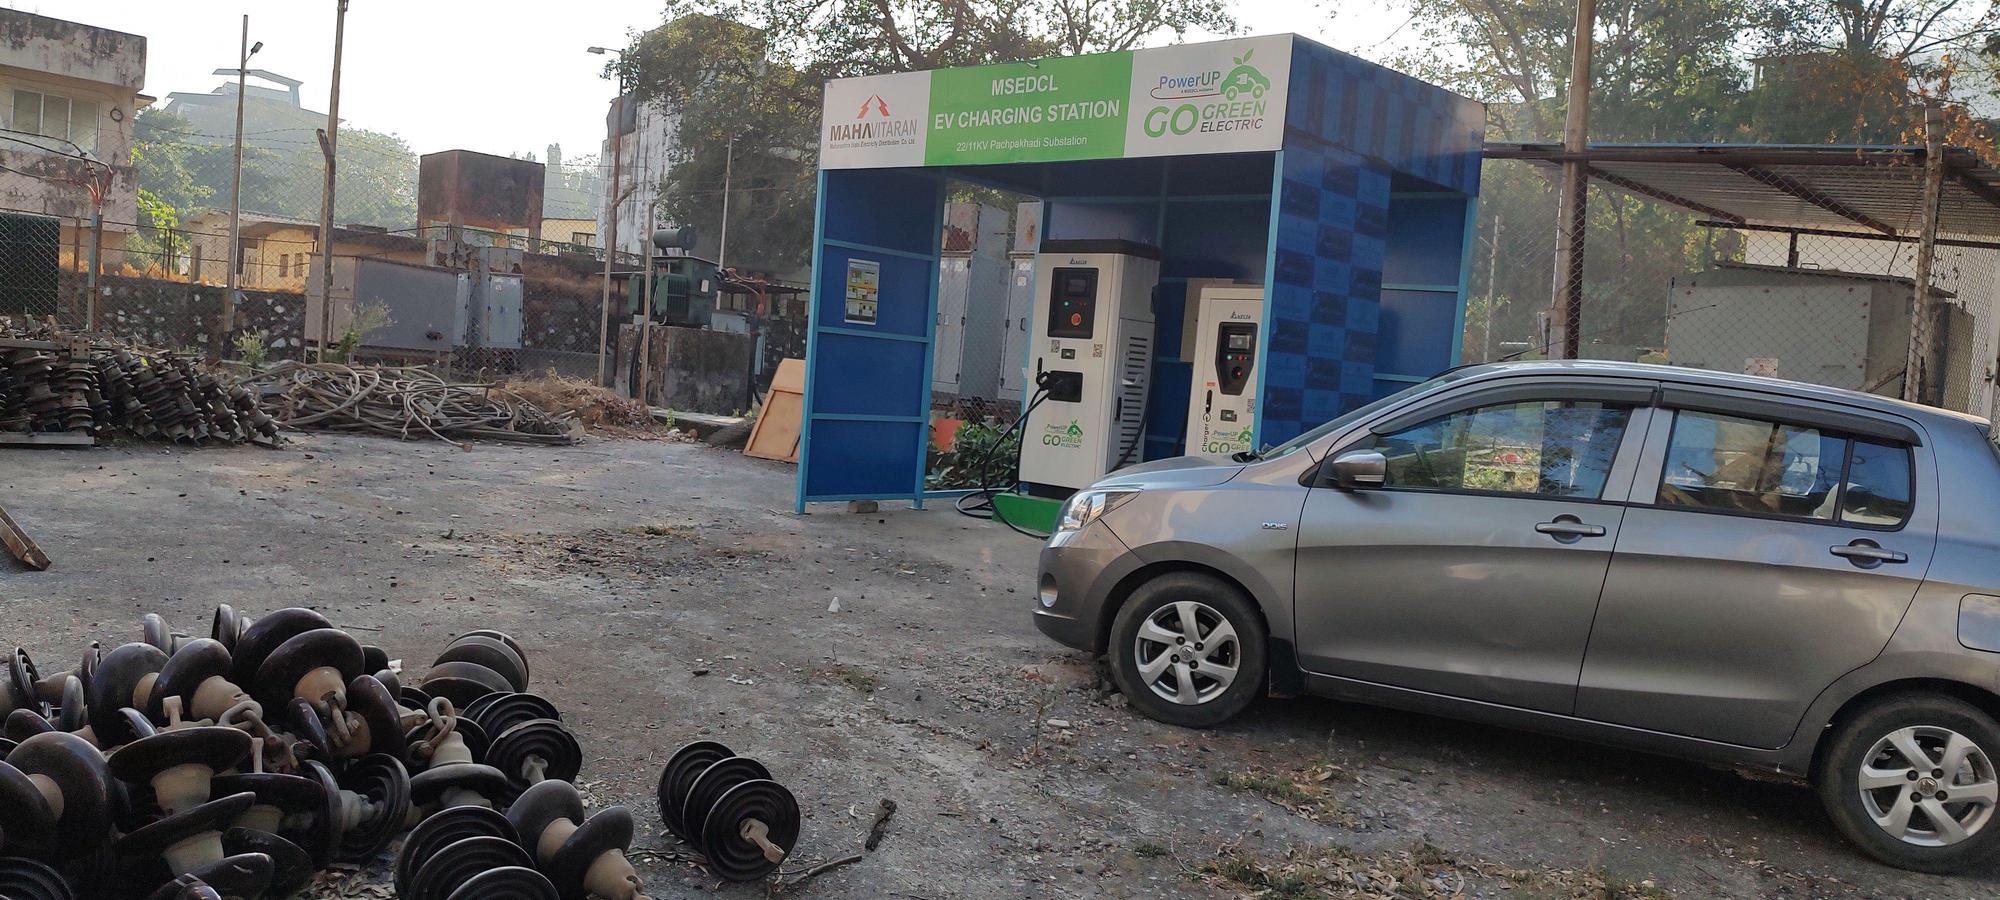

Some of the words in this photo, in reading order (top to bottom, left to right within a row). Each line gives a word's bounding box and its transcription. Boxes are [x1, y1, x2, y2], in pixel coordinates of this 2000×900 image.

[991, 75, 1058, 96] MSEDCL
[1159, 71, 1221, 89] PowerUP
[934, 113, 955, 130] EV
[958, 106, 1042, 129] CHARGING
[1047, 99, 1120, 123] STATION
[1202, 101, 1266, 119] GREEN
[1143, 103, 1200, 138] GO
[1200, 118, 1264, 133] ELECTRIC
[830, 119, 918, 142] MAHAVITARAN
[956, 138, 988, 152] 22/11KV
[990, 138, 1041, 151] Pachpakhadi
[1043, 135, 1088, 147] Substation
[1042, 434, 1061, 446] GO
[1202, 423, 1210, 453] Charger
[1208, 441, 1231, 454] GO
